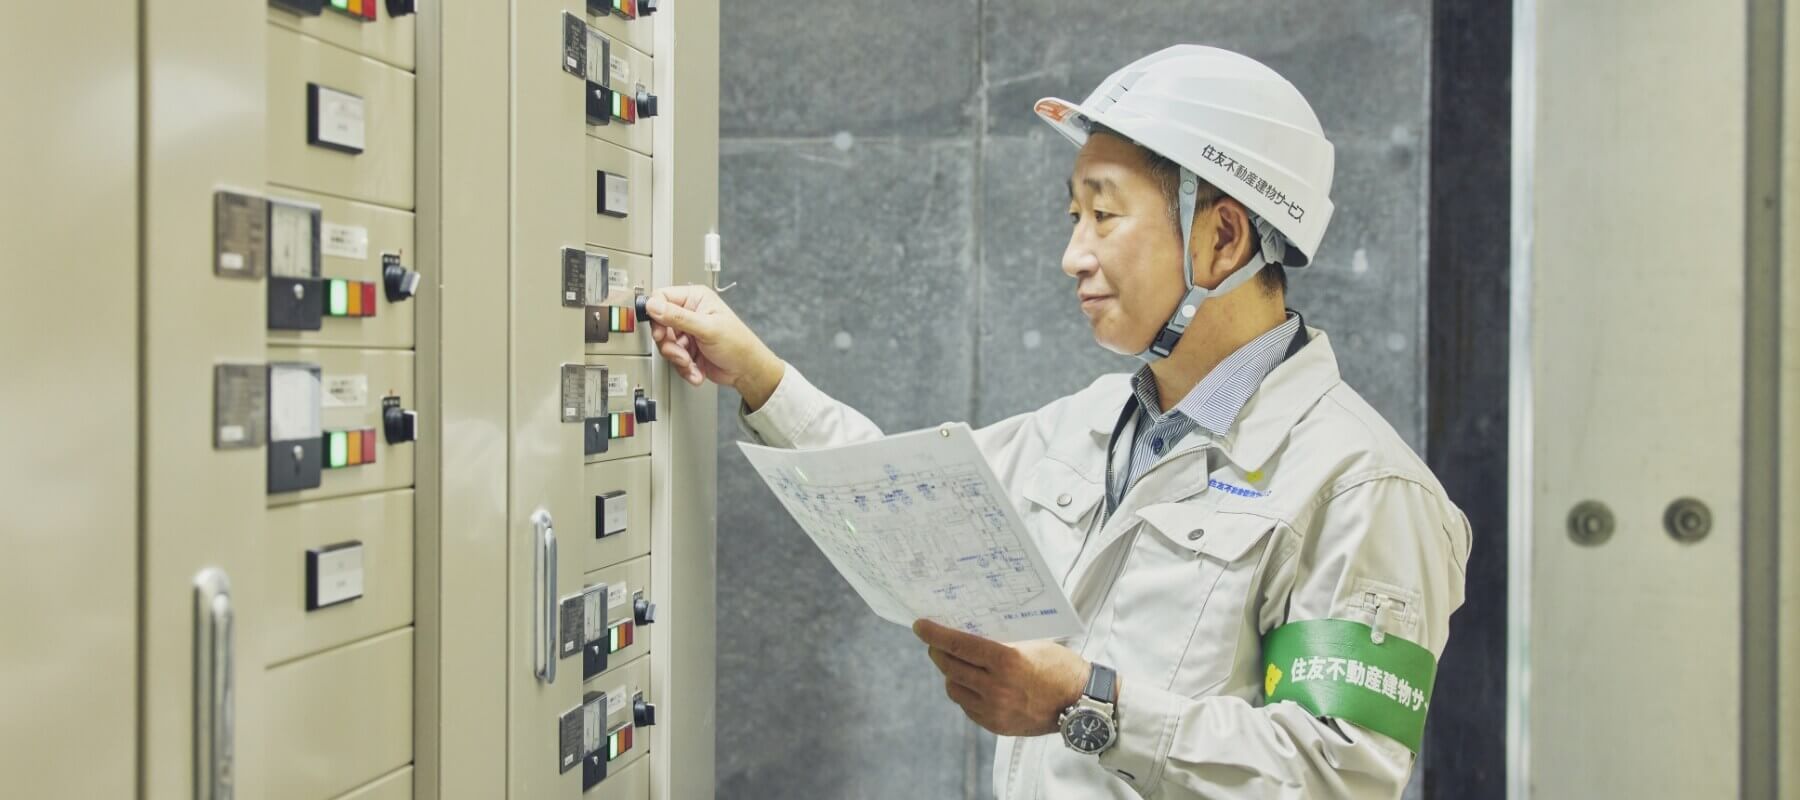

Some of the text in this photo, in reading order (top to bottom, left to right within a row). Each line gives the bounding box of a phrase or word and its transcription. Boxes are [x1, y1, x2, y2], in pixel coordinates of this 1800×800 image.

[1201, 143, 1305, 223] 住友不動産建物サービス
[1290, 655, 1429, 712] 住友不動産建物サ
